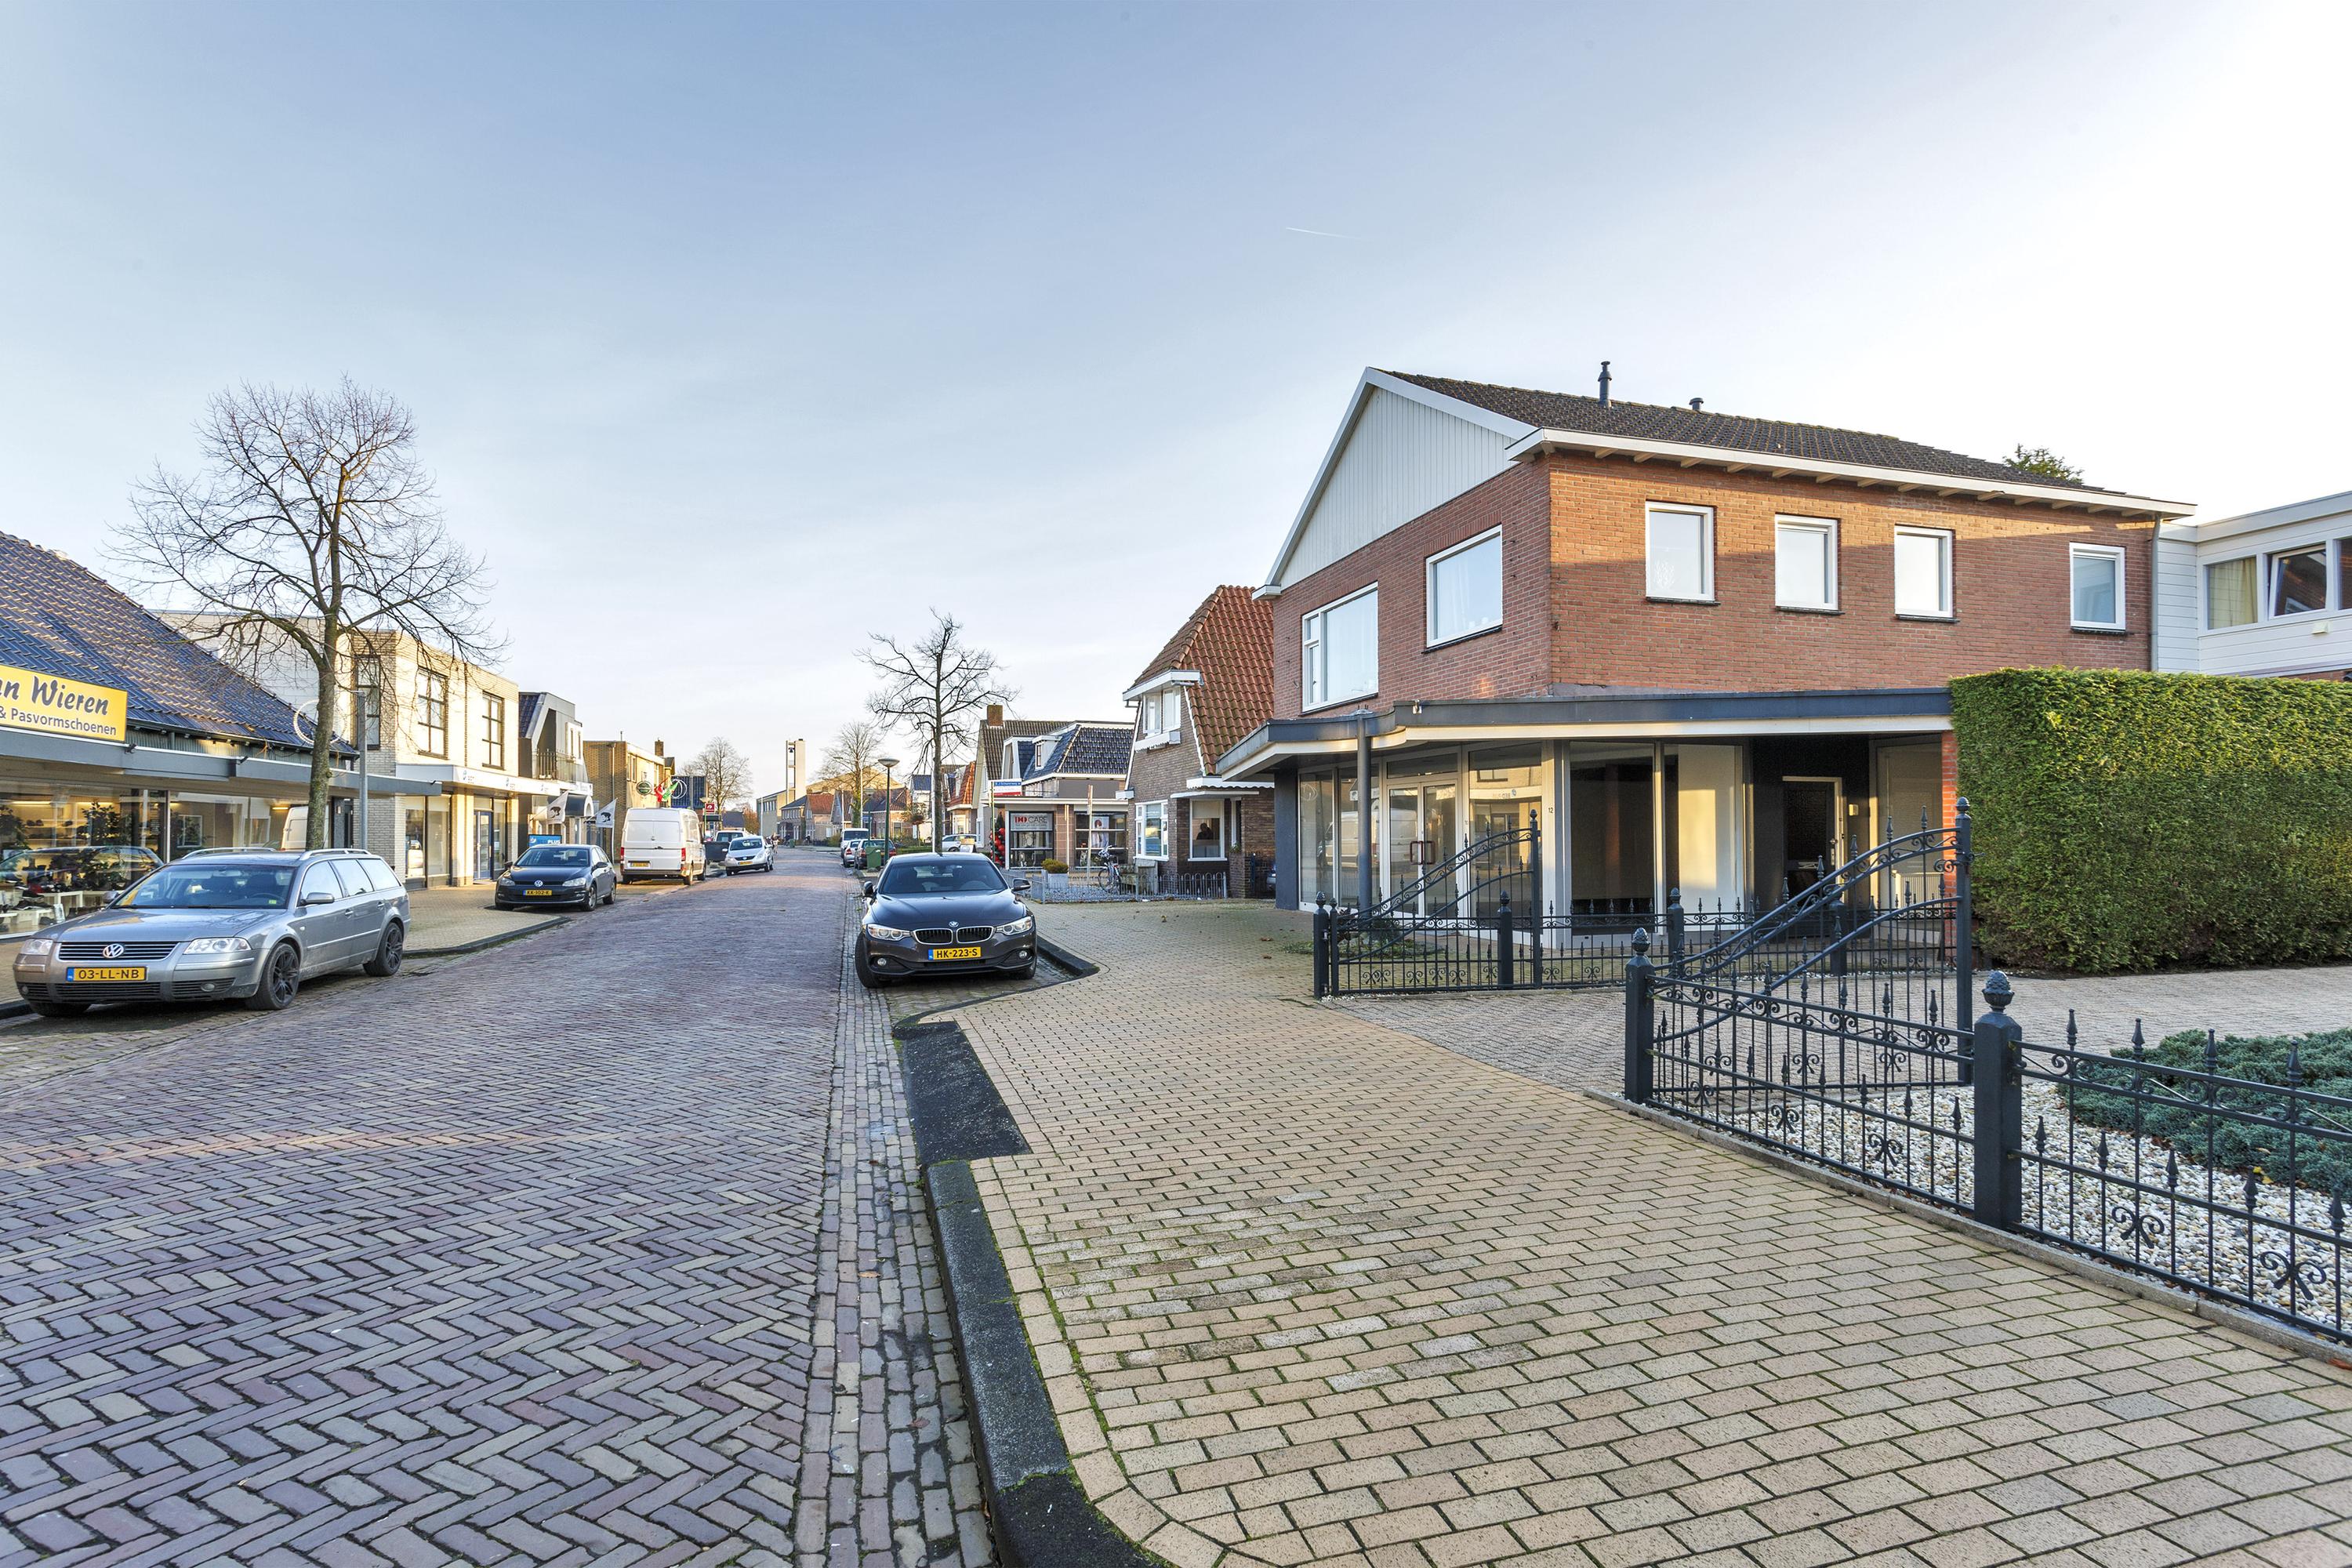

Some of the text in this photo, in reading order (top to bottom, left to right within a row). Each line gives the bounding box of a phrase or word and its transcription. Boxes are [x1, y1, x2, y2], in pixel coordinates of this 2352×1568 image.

[0, 676, 109, 715] n Wieren
[11, 708, 116, 735] Pasvormschoenen
[936, 948, 978, 958] HK-223-S
[78, 969, 139, 979] 03-LL-NB
